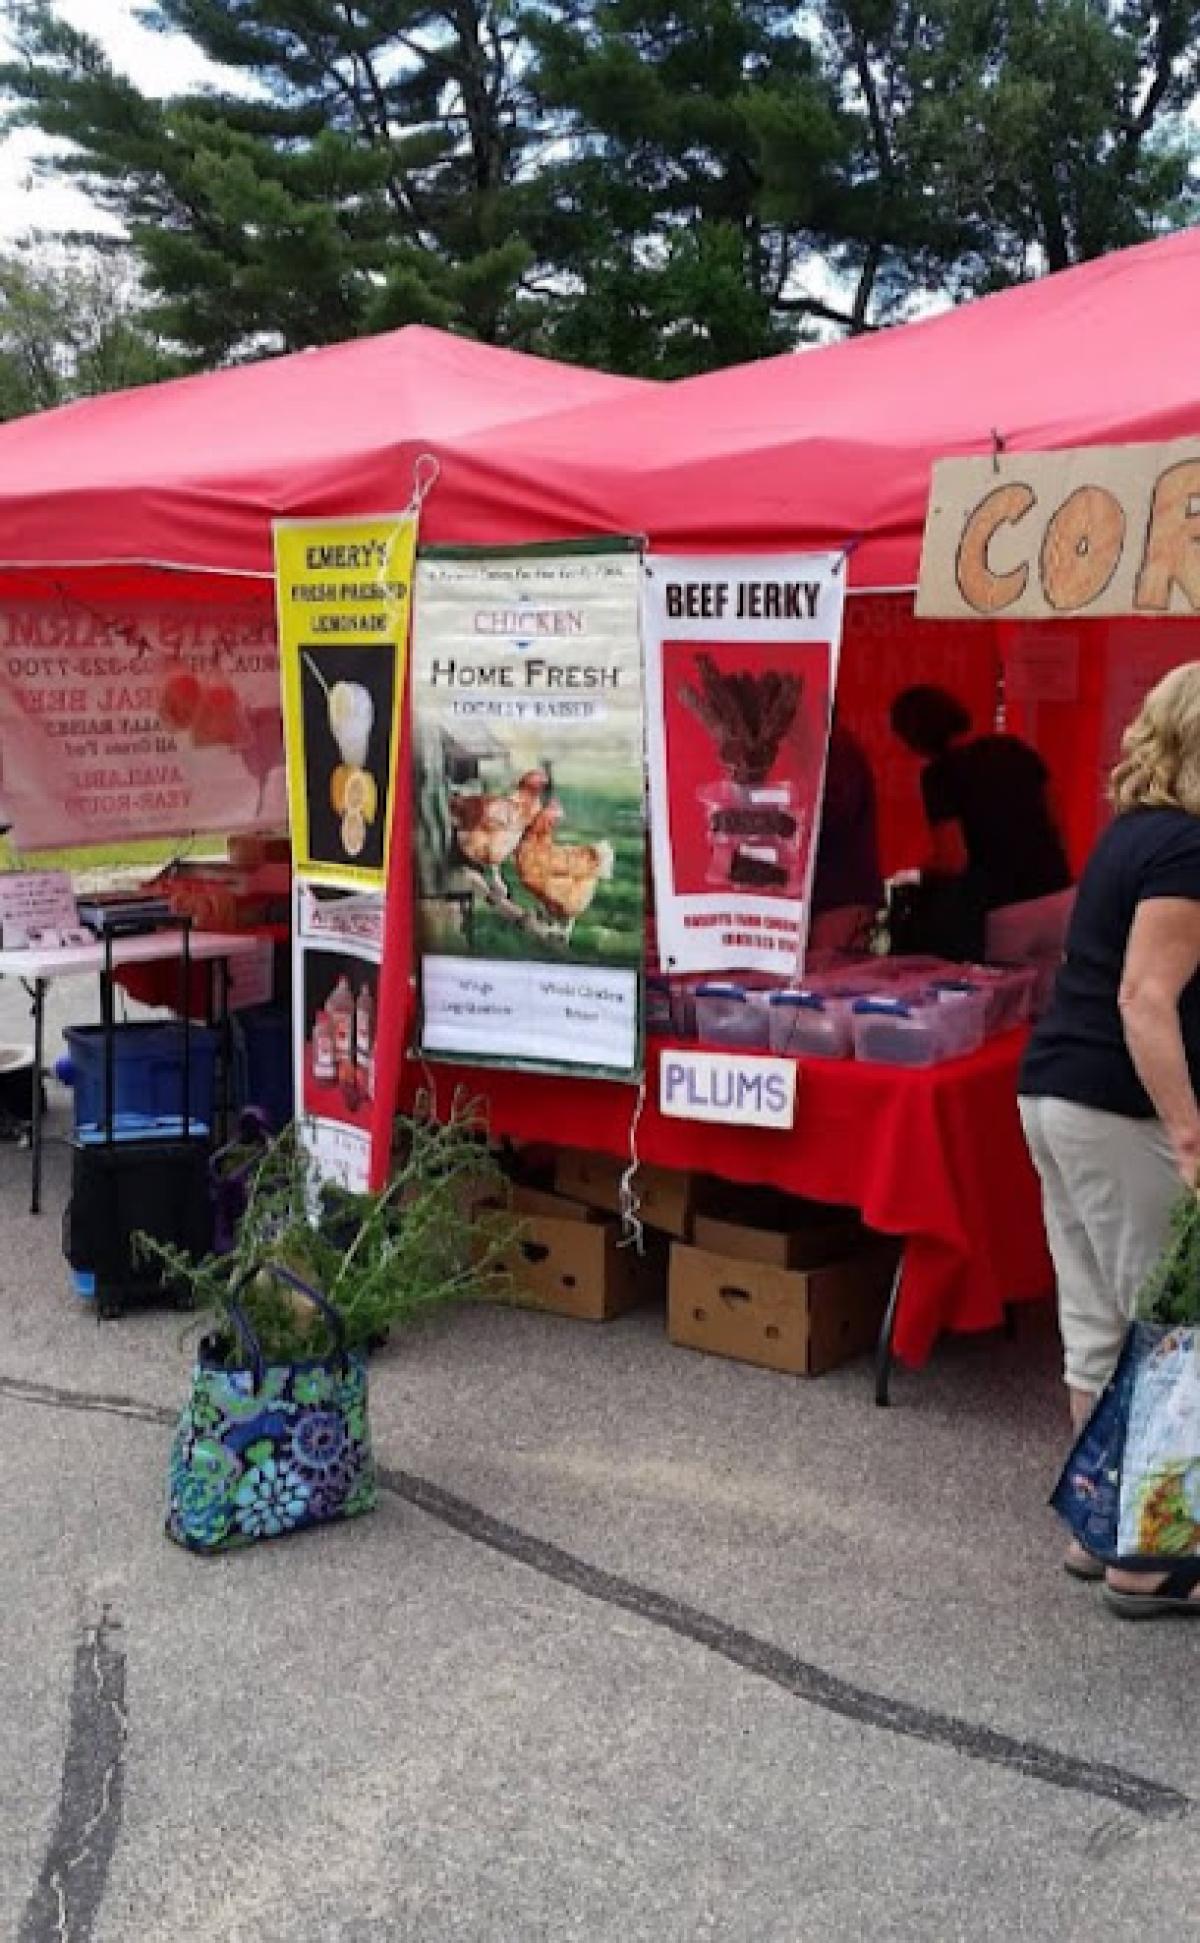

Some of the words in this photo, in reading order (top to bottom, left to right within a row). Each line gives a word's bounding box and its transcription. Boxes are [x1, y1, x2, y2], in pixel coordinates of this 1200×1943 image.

[666, 582, 729, 620] BEEF
[736, 581, 821, 620] JERKY
[475, 611, 583, 635] CHICKEN
[431, 659, 513, 688] HOME
[525, 659, 620, 688] FRESH
[666, 1064, 787, 1112] PLUMS
